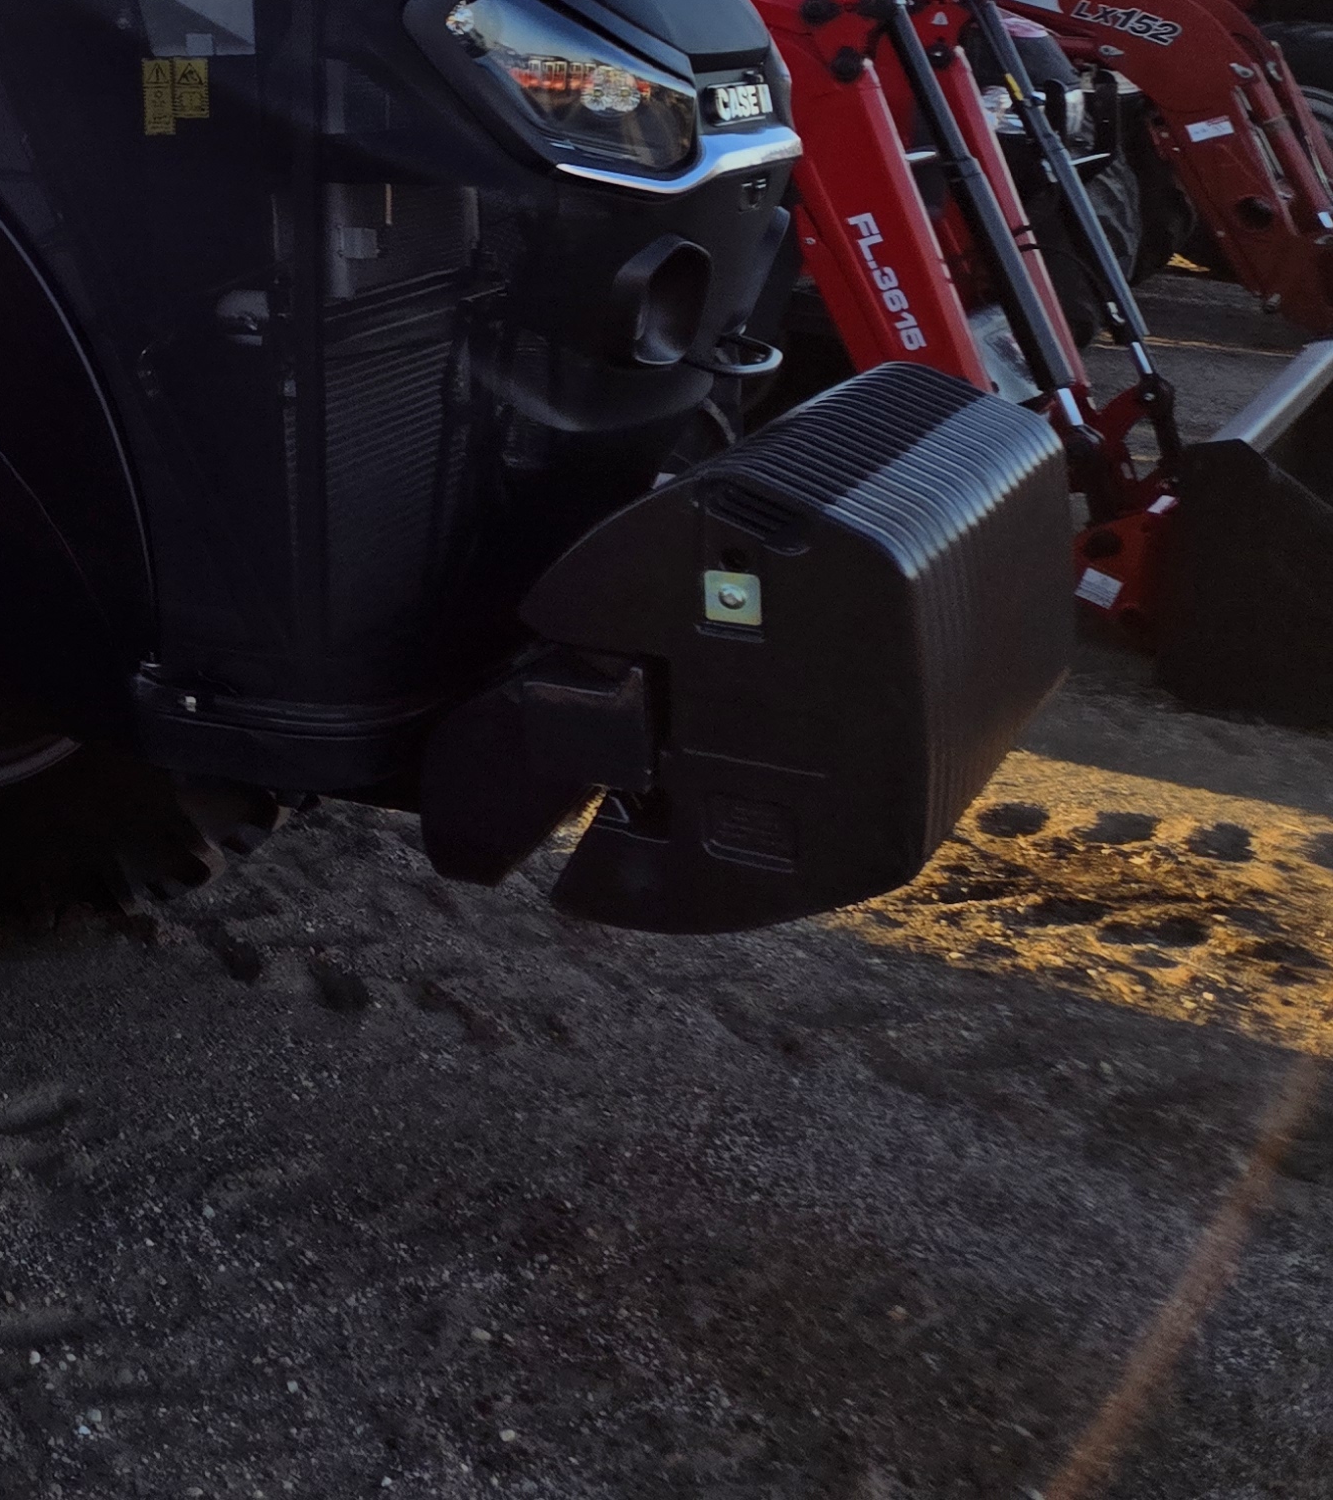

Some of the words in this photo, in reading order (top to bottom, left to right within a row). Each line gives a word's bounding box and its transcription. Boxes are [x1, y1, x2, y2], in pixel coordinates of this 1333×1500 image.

[1071, 0, 1183, 46] LX152
[715, 85, 760, 121] CASE
[846, 211, 927, 351] FL.3615
